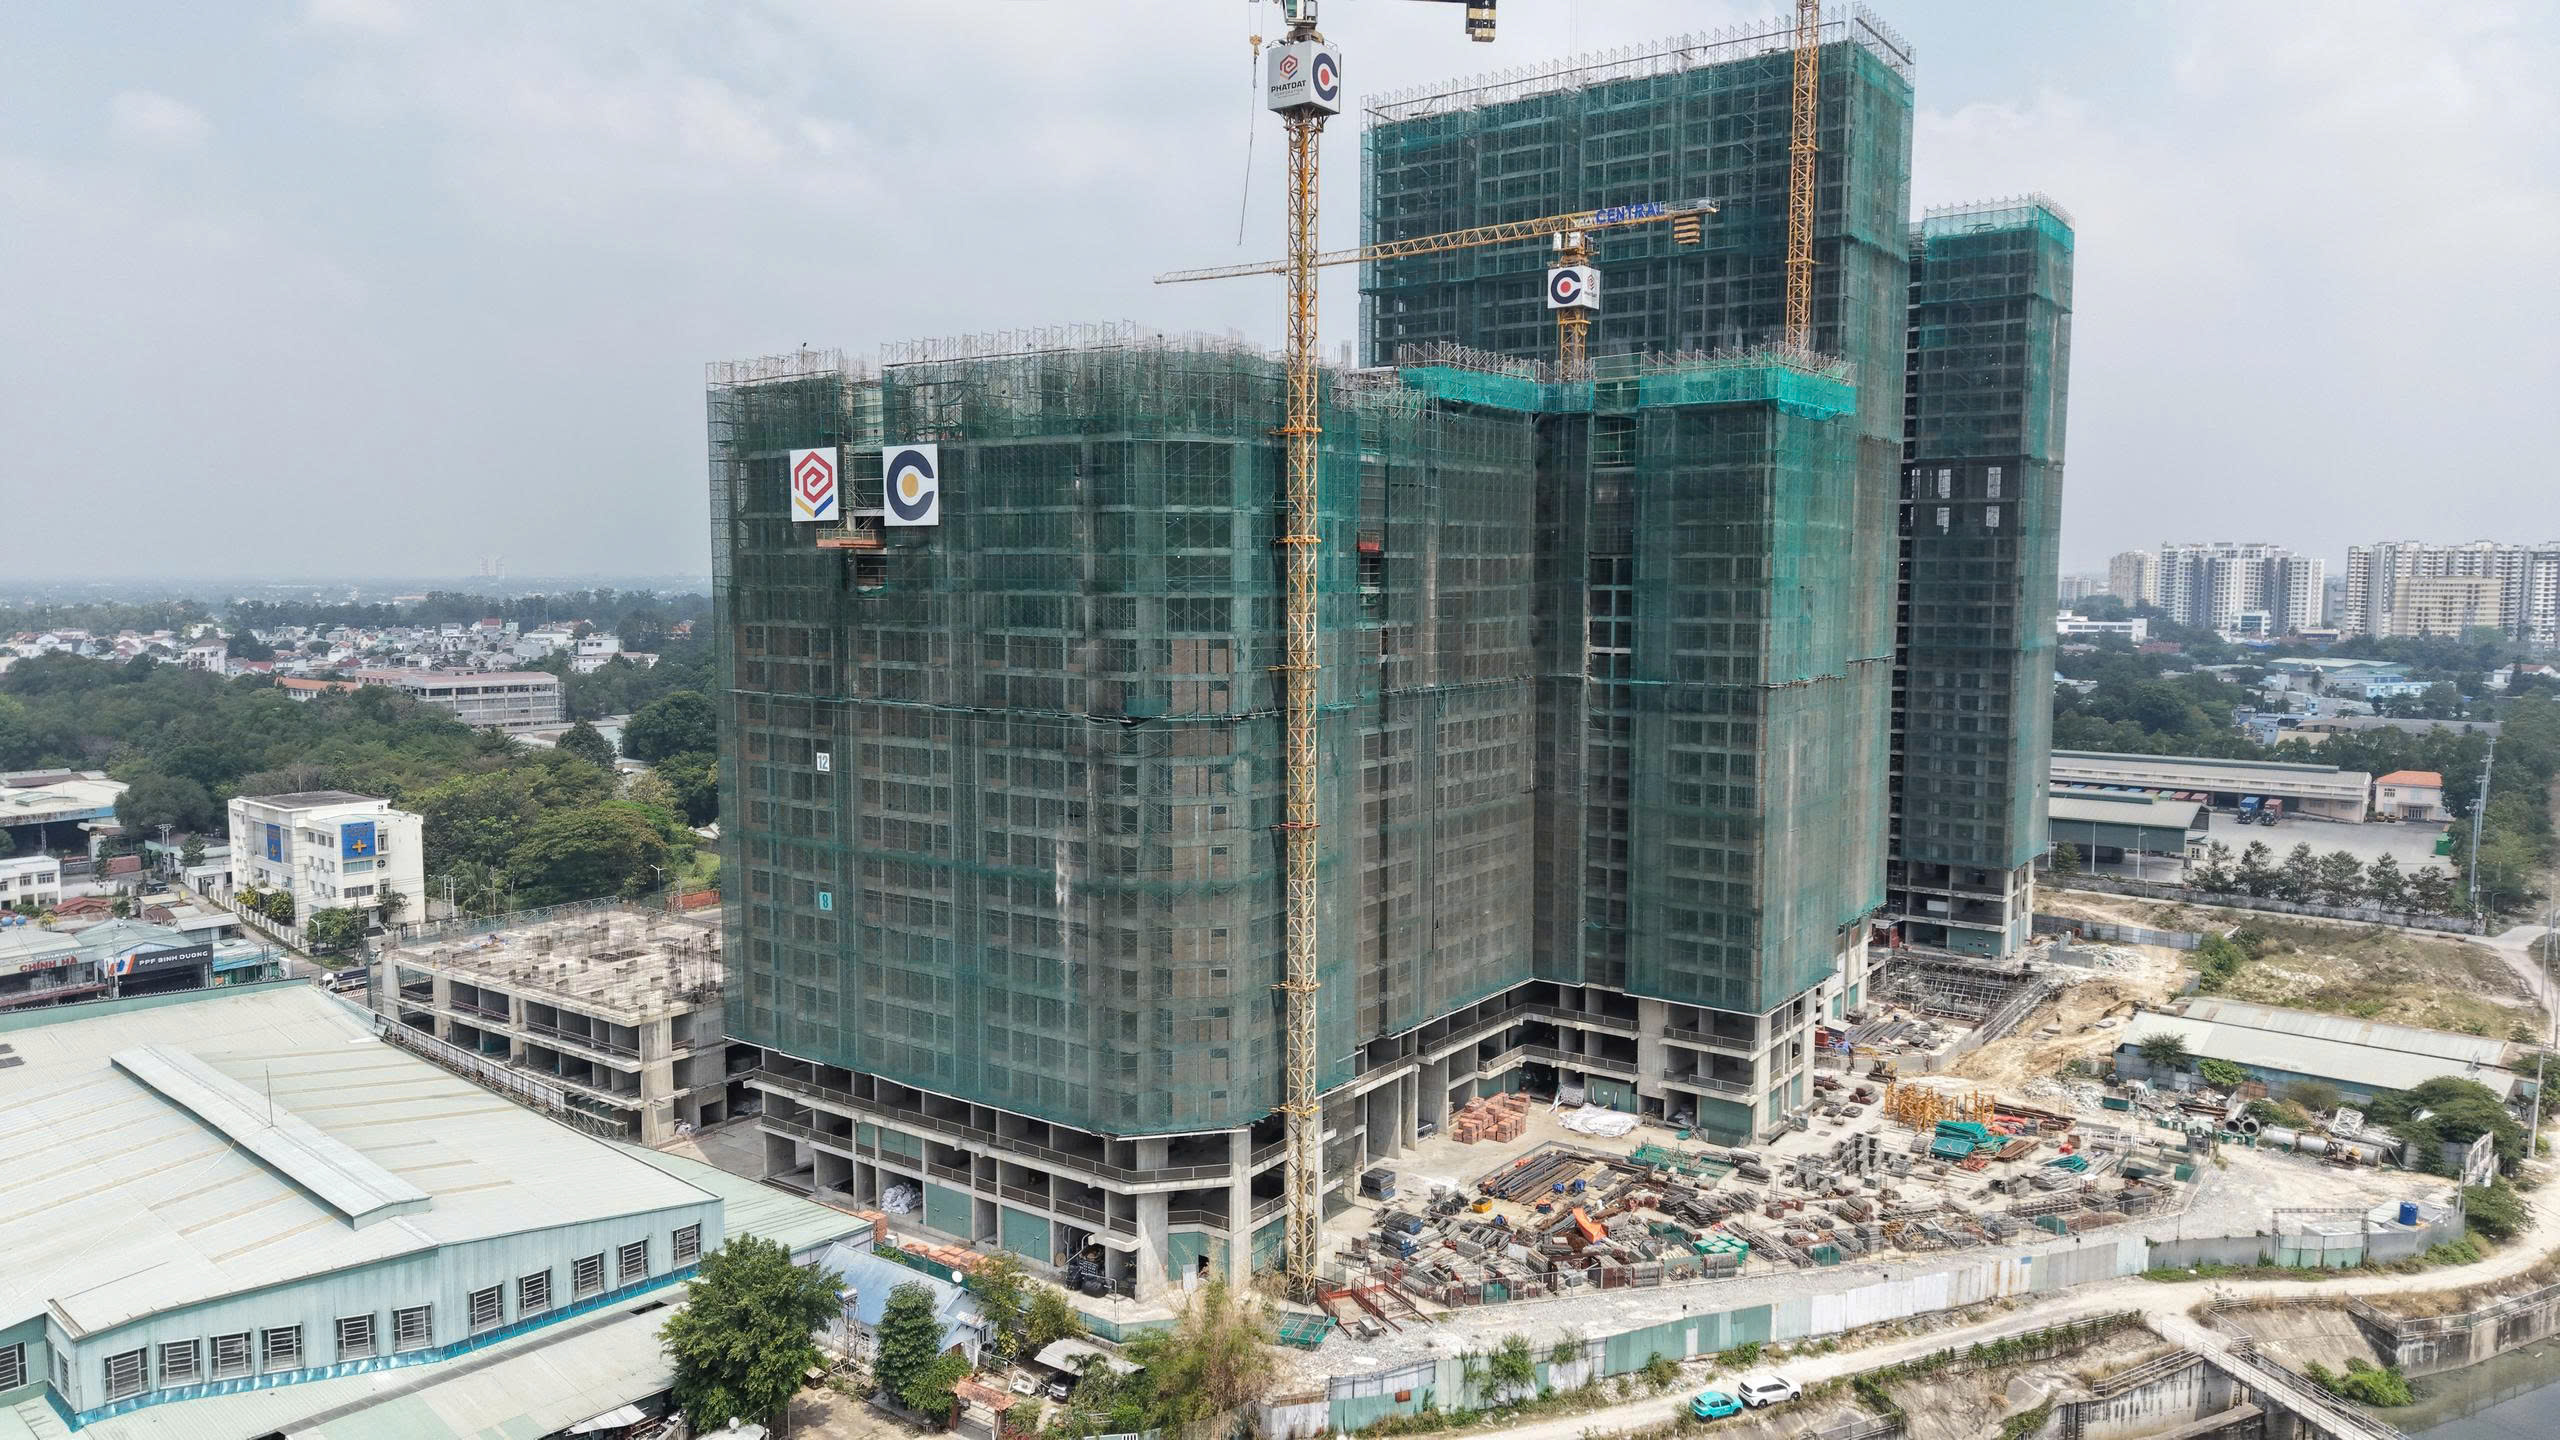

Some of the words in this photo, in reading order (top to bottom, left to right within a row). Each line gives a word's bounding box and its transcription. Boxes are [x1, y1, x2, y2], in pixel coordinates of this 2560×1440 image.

[1271, 80, 1306, 93] PHATDAT
[1596, 201, 1665, 224] CENTRAL
[818, 754, 829, 770] 12
[179, 951, 208, 960] DUONG
